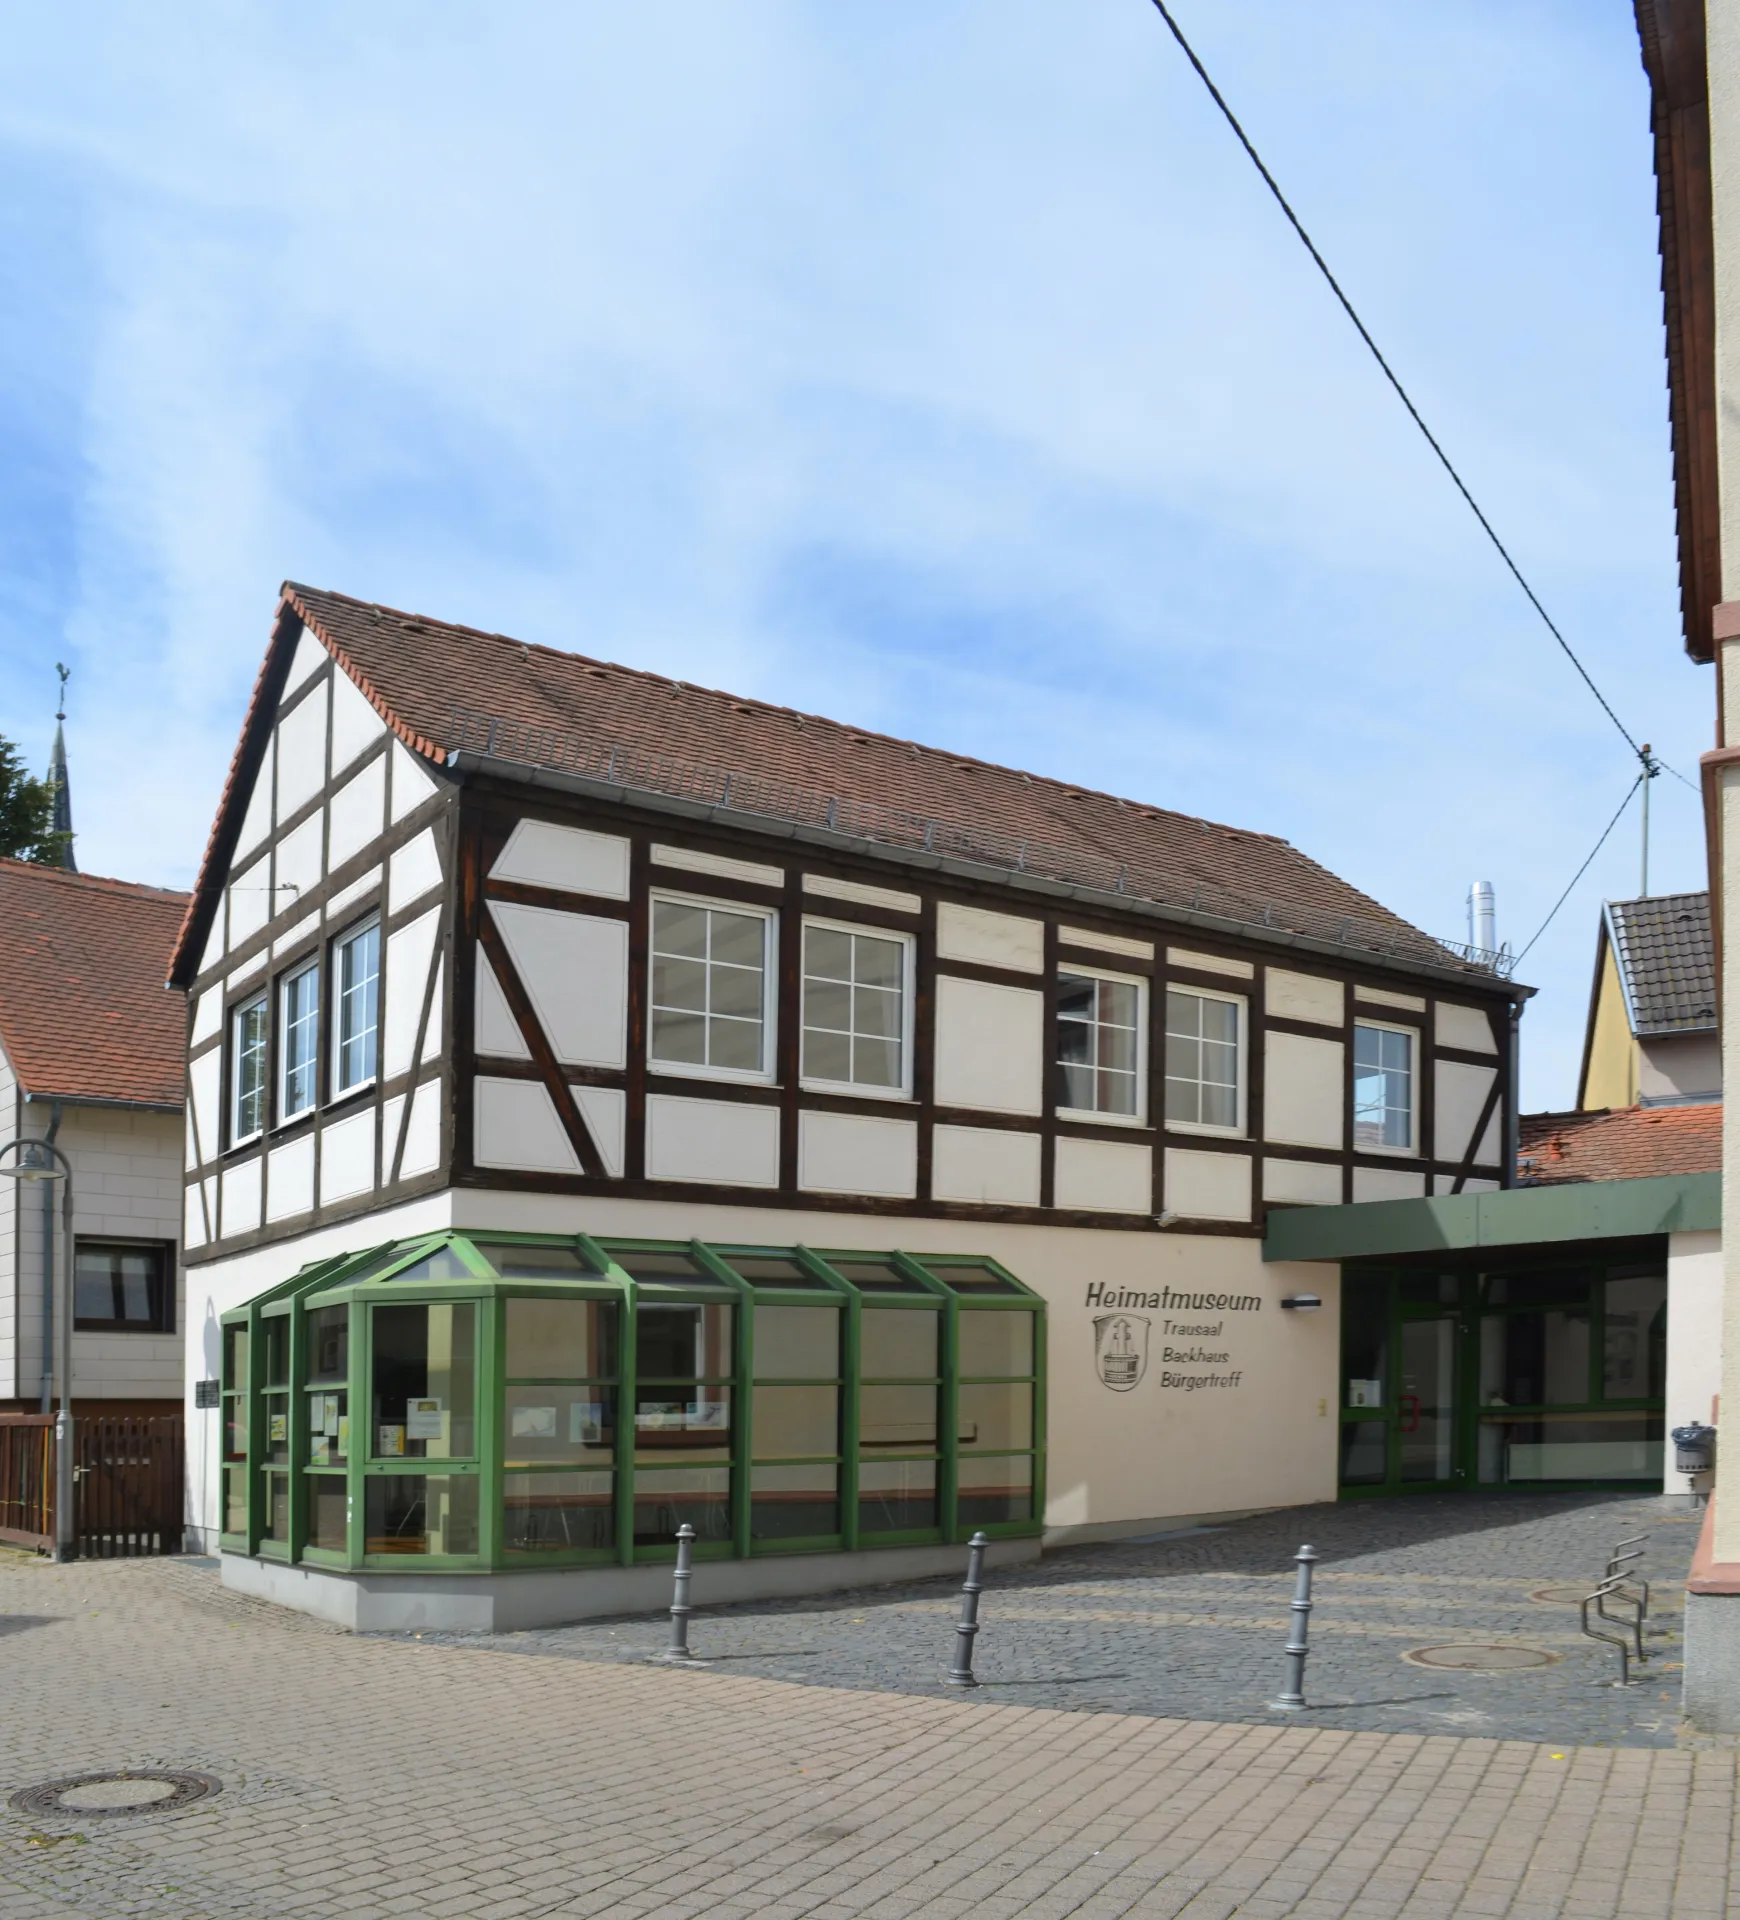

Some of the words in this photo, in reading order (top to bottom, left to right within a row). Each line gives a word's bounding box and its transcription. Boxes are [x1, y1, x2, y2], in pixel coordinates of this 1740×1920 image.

[1085, 1281, 1262, 1311] Heimatmuseum
[1163, 1320, 1223, 1336] Trausaal
[1162, 1347, 1230, 1363] Backhaus
[1160, 1371, 1243, 1391] Bürgertreff
